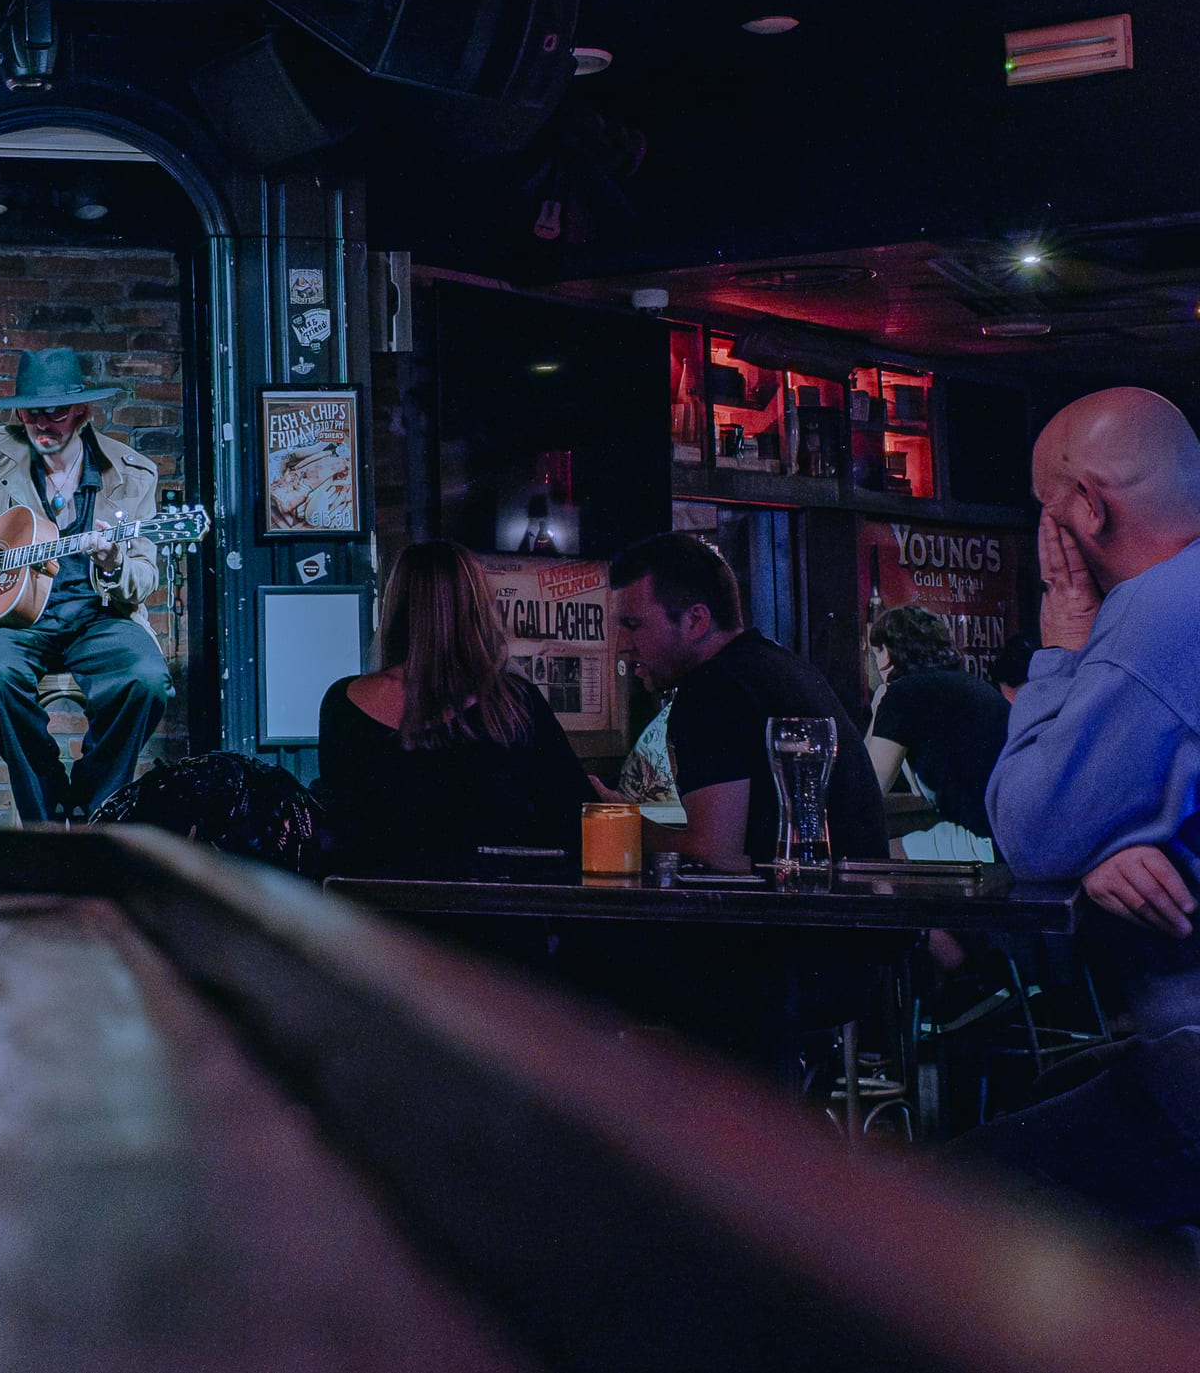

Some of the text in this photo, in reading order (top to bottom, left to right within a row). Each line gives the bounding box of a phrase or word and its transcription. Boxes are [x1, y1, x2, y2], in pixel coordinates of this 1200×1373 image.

[270, 403, 346, 431] FISH & CHIPS
[270, 423, 316, 448] FRIDAY
[890, 523, 1001, 573] YOUNG'S
[914, 570, 943, 588] Gold
[513, 599, 605, 641] GALLAGHER
[941, 613, 1006, 649] NTAIN
